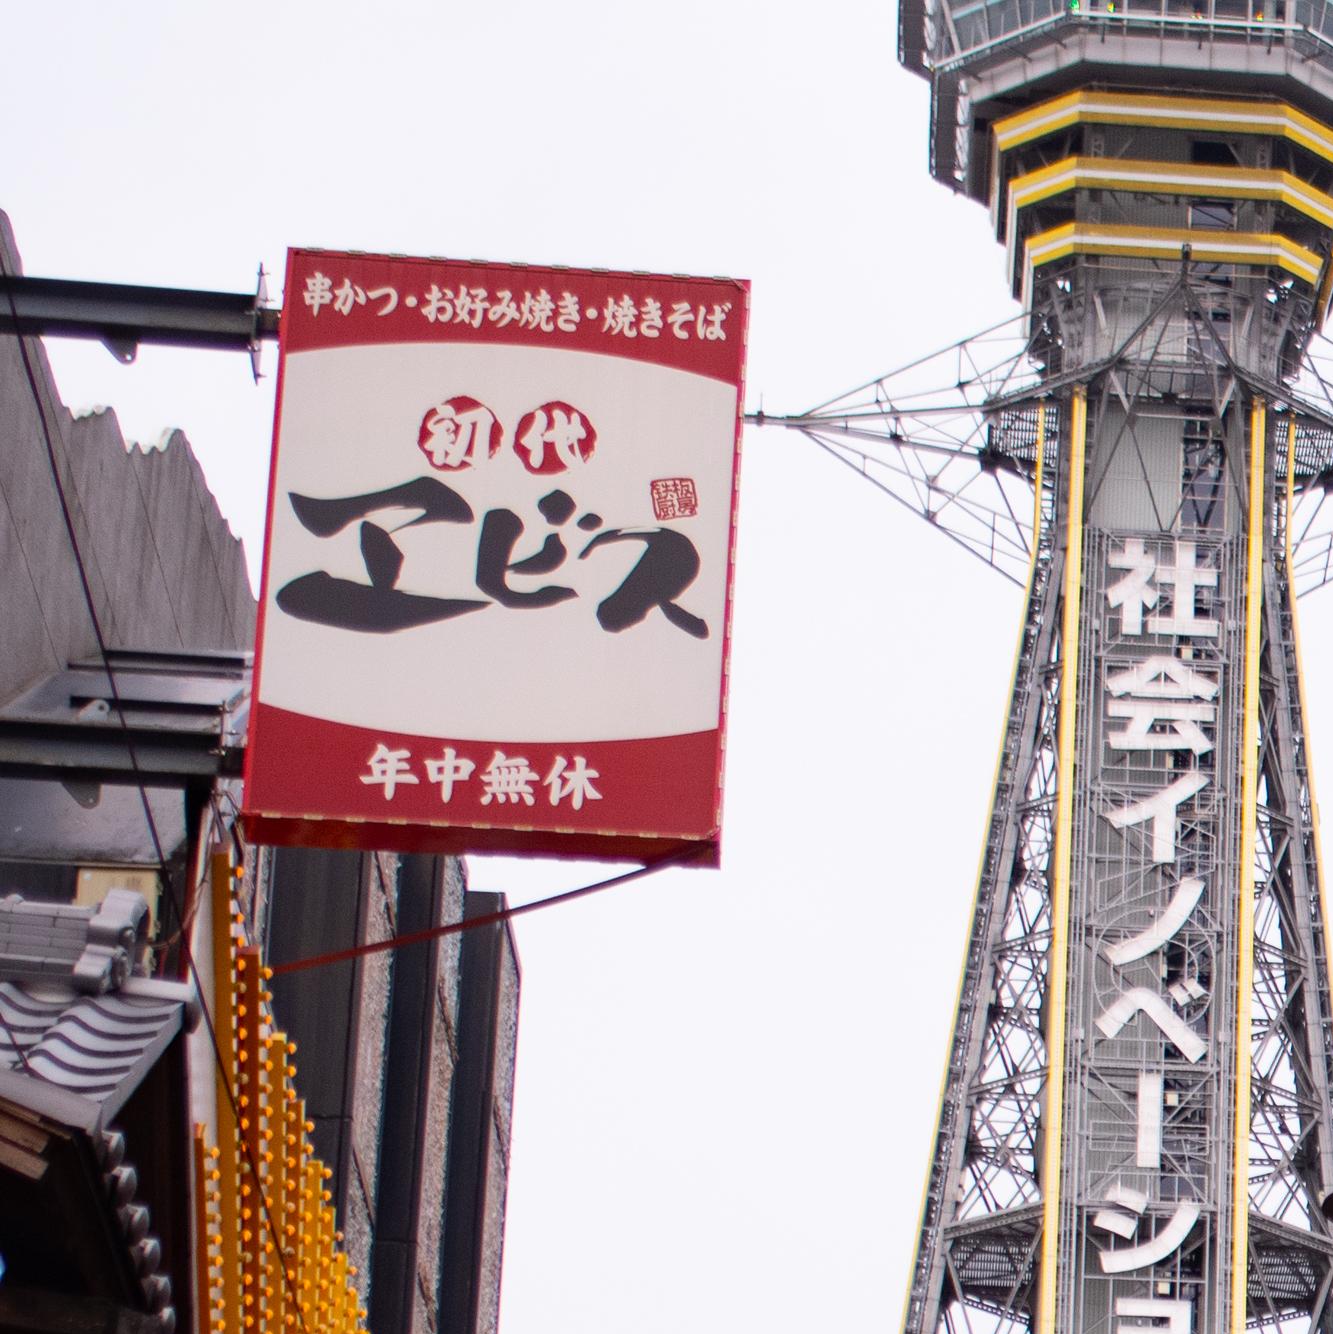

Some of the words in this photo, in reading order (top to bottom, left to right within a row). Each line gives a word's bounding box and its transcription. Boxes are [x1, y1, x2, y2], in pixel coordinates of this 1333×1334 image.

[422, 402, 594, 470] 初代
[276, 476, 710, 639] エビス
[359, 743, 604, 810] 年中無休
